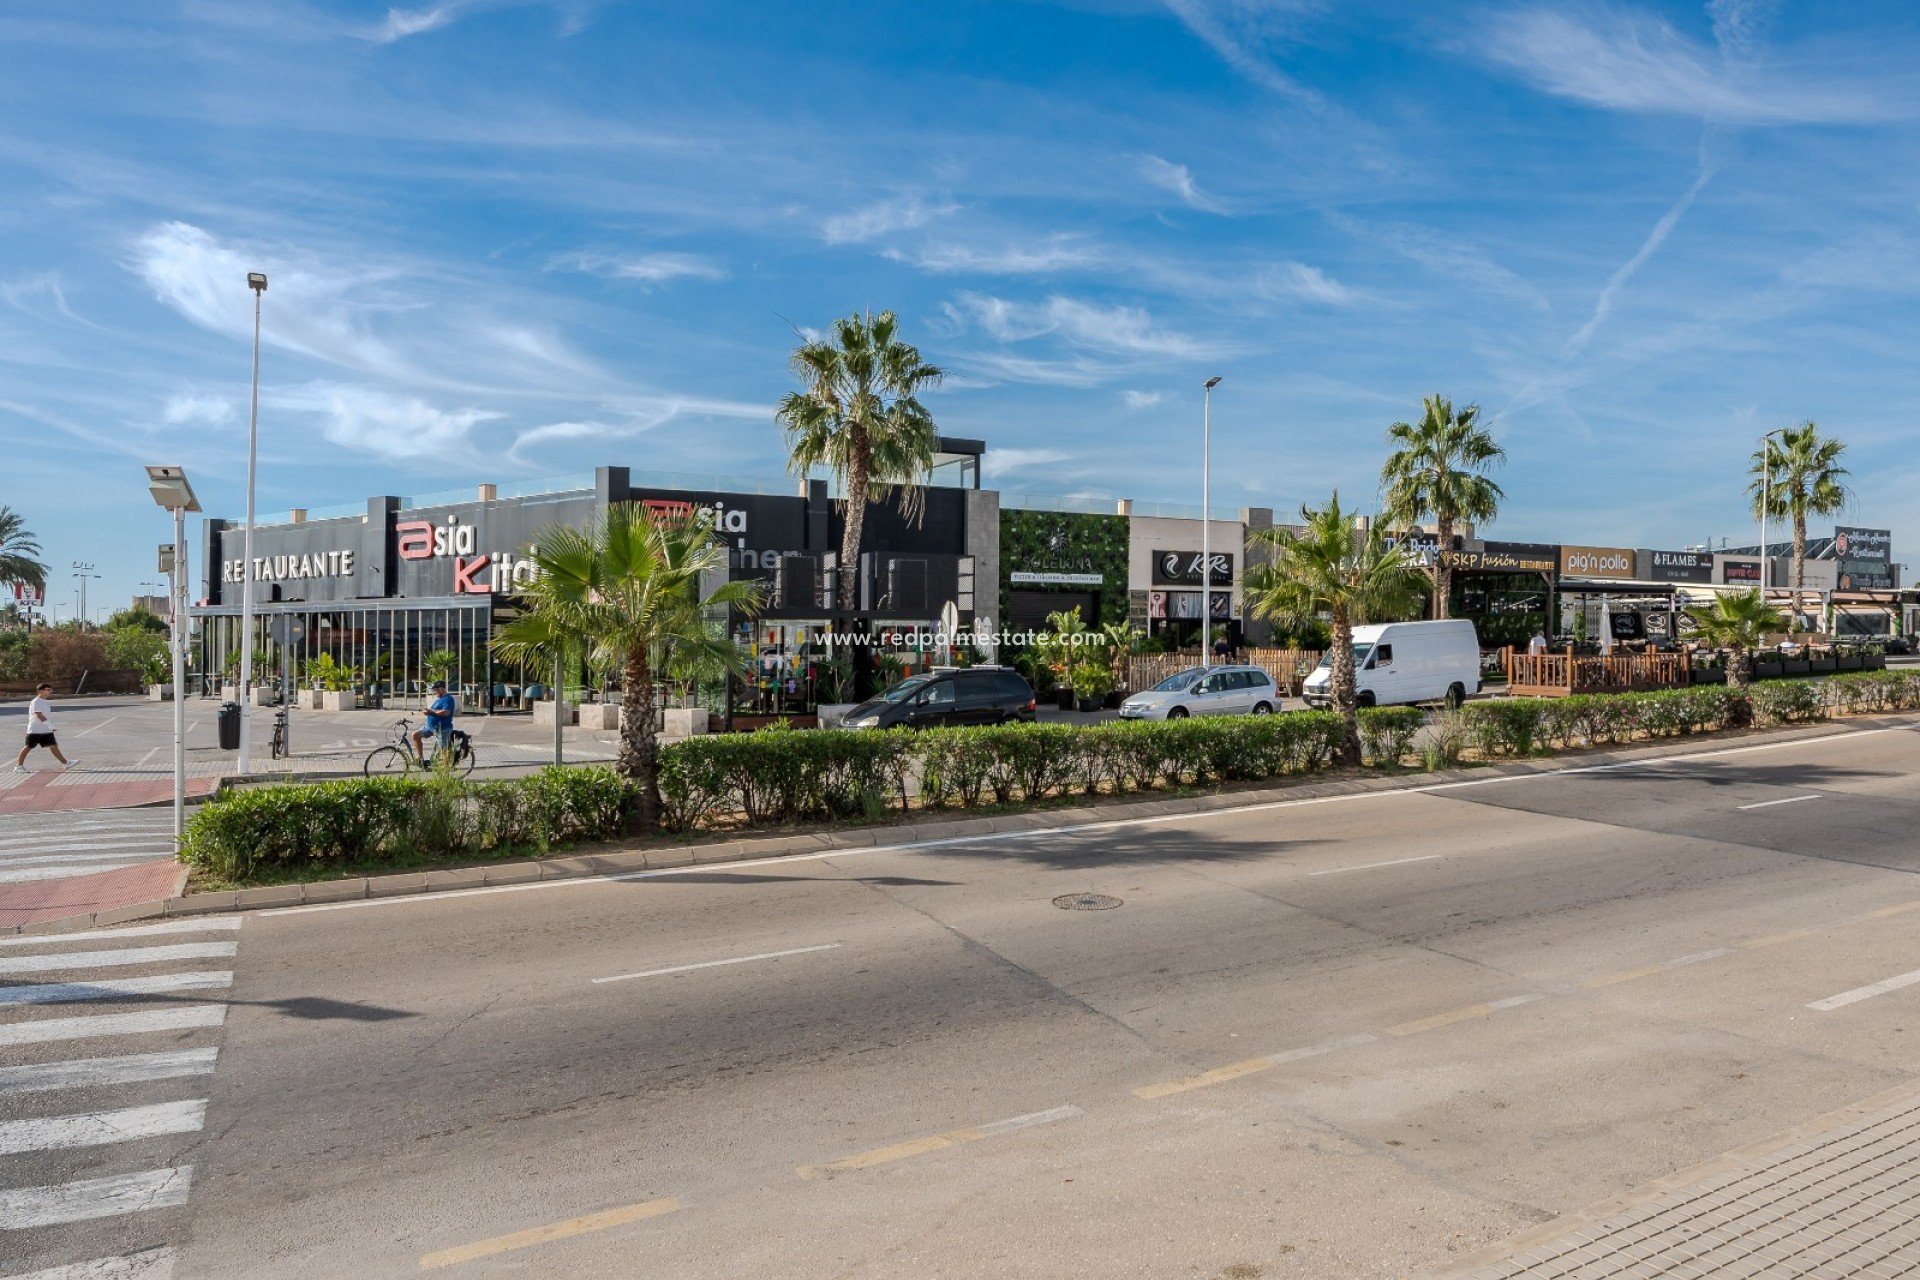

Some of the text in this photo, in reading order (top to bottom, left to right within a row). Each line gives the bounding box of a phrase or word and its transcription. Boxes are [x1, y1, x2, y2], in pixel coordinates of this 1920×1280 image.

[1410, 538, 1441, 555] Bridg
[222, 549, 354, 583] RETAURANTE
[1452, 553, 1478, 567] SKP
[1600, 554, 1629, 572] pollo
[1662, 553, 1698, 567] FLAMES
